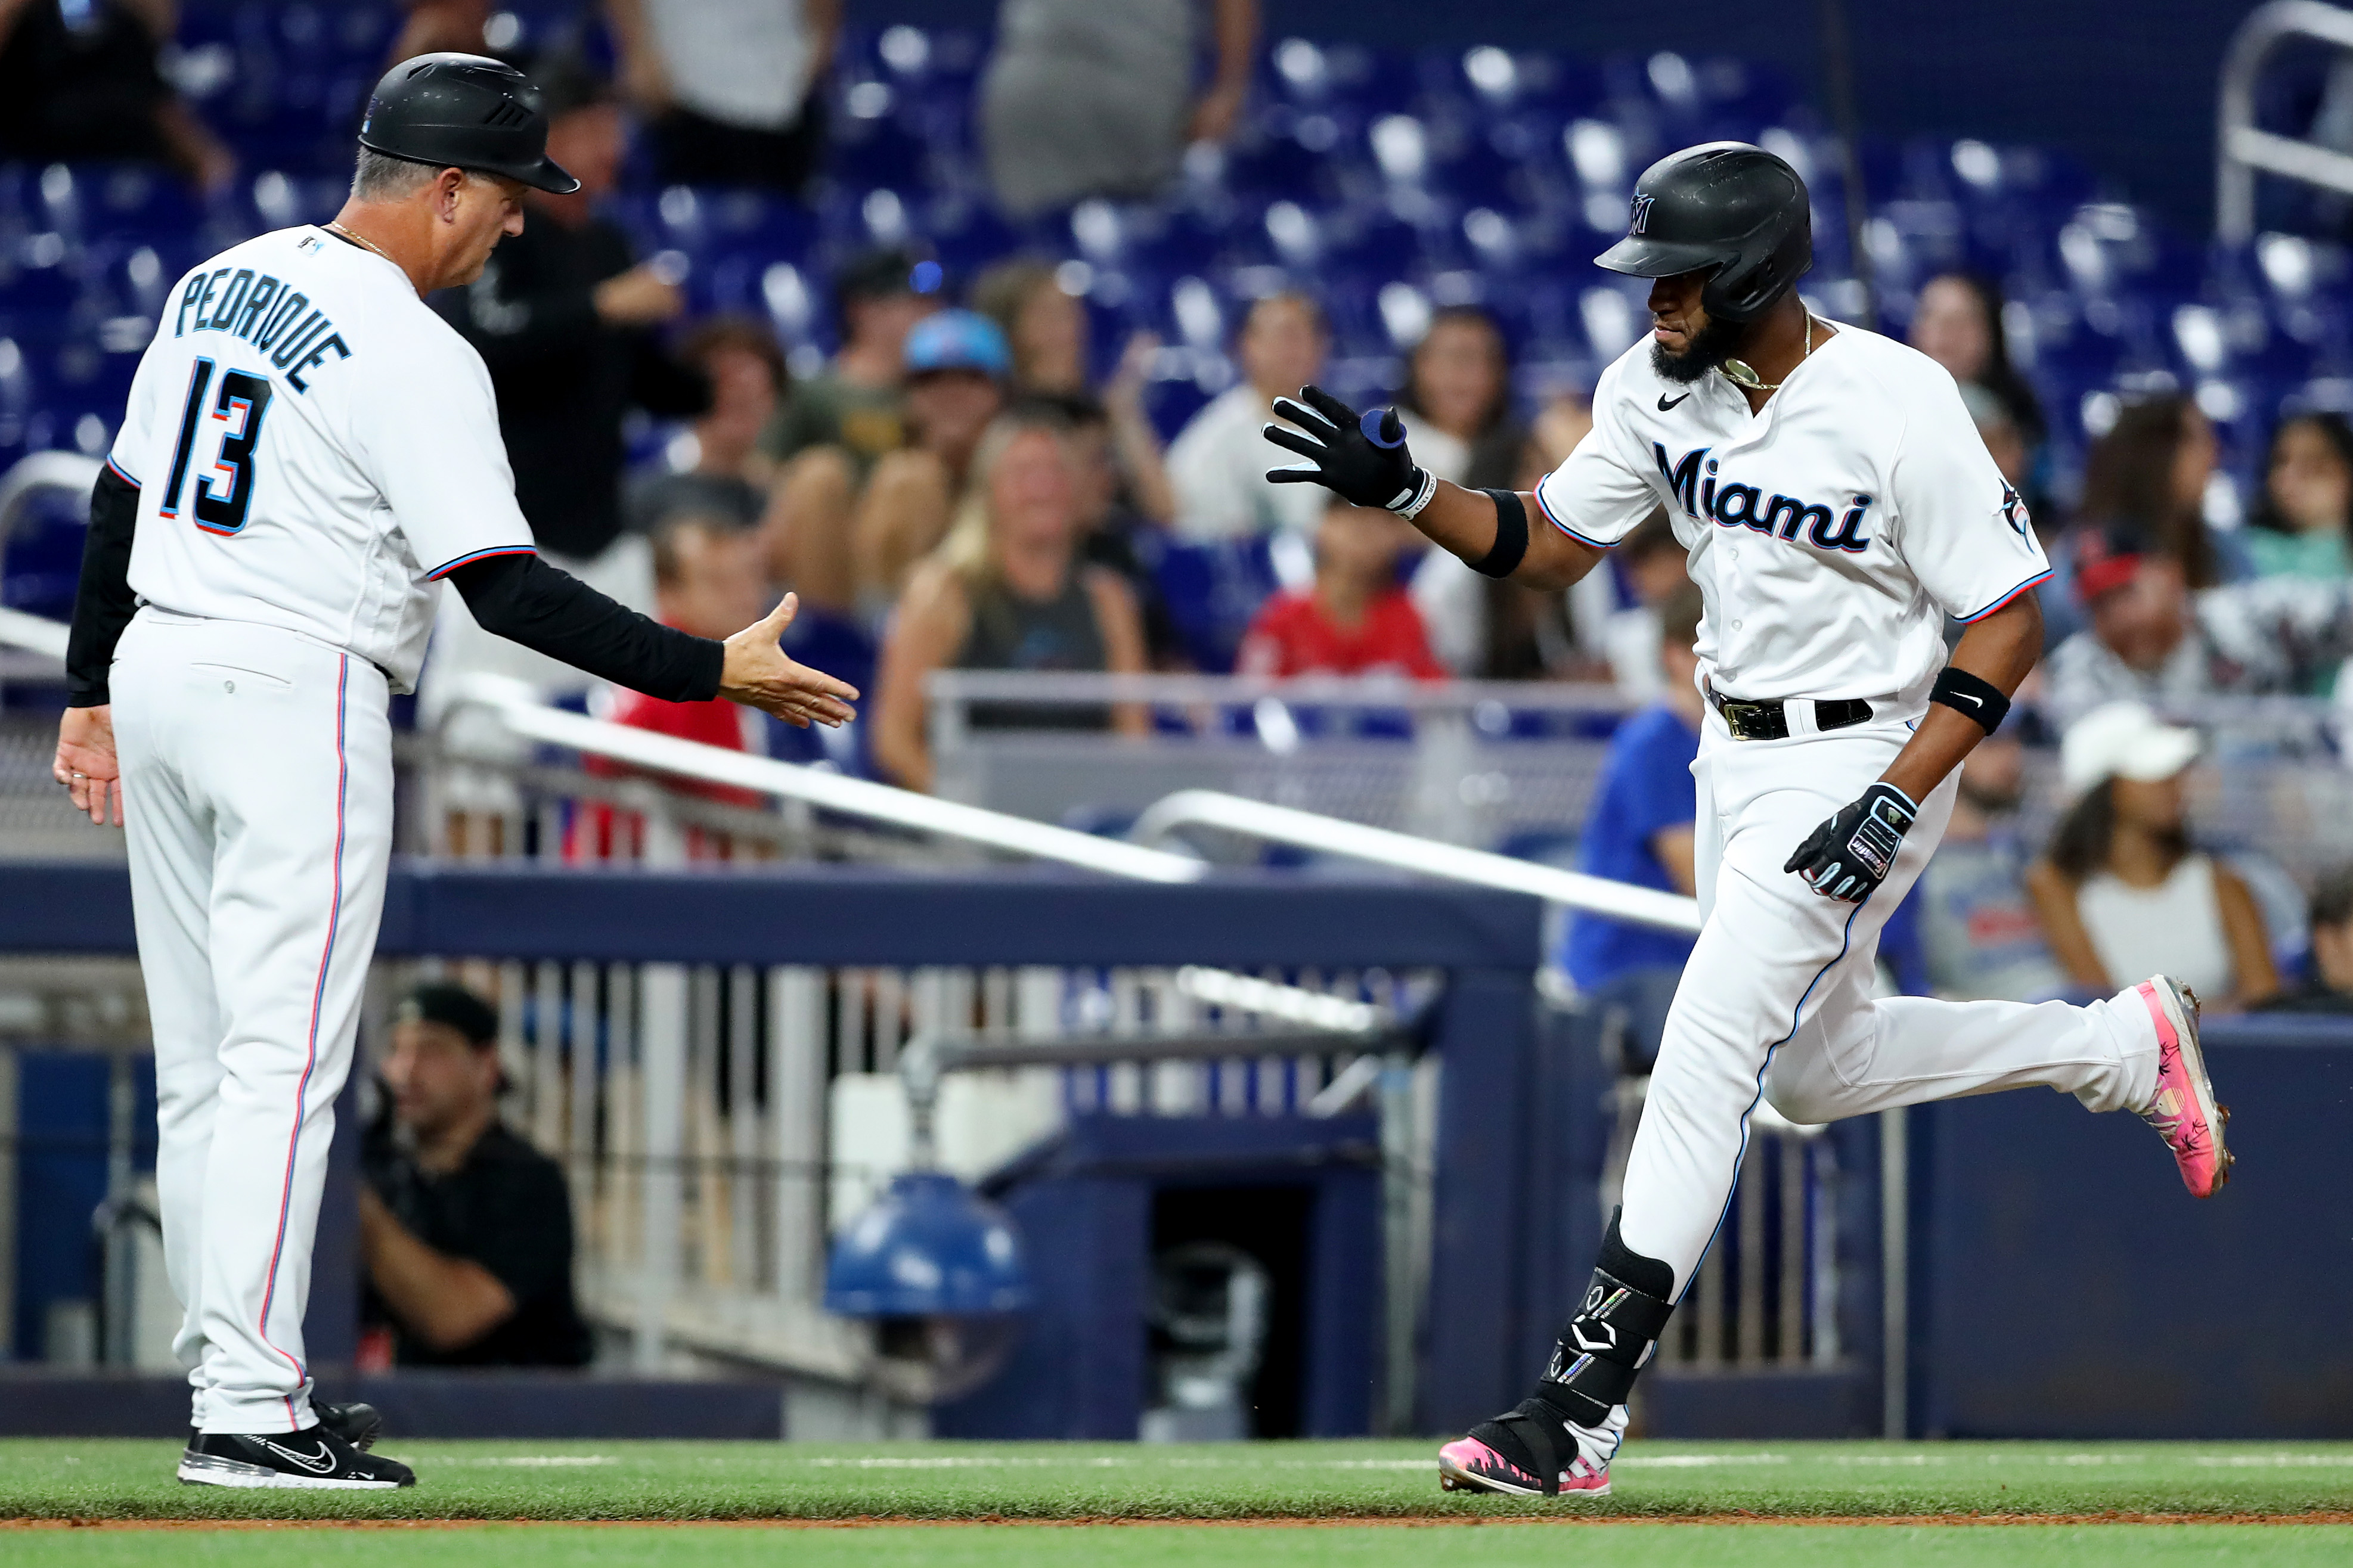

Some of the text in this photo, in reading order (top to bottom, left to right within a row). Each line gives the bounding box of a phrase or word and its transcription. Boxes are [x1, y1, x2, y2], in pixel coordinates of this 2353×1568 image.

[175, 268, 353, 395] PEDRIQUE
[160, 356, 274, 537] 13
[1653, 441, 1873, 553] Miami
